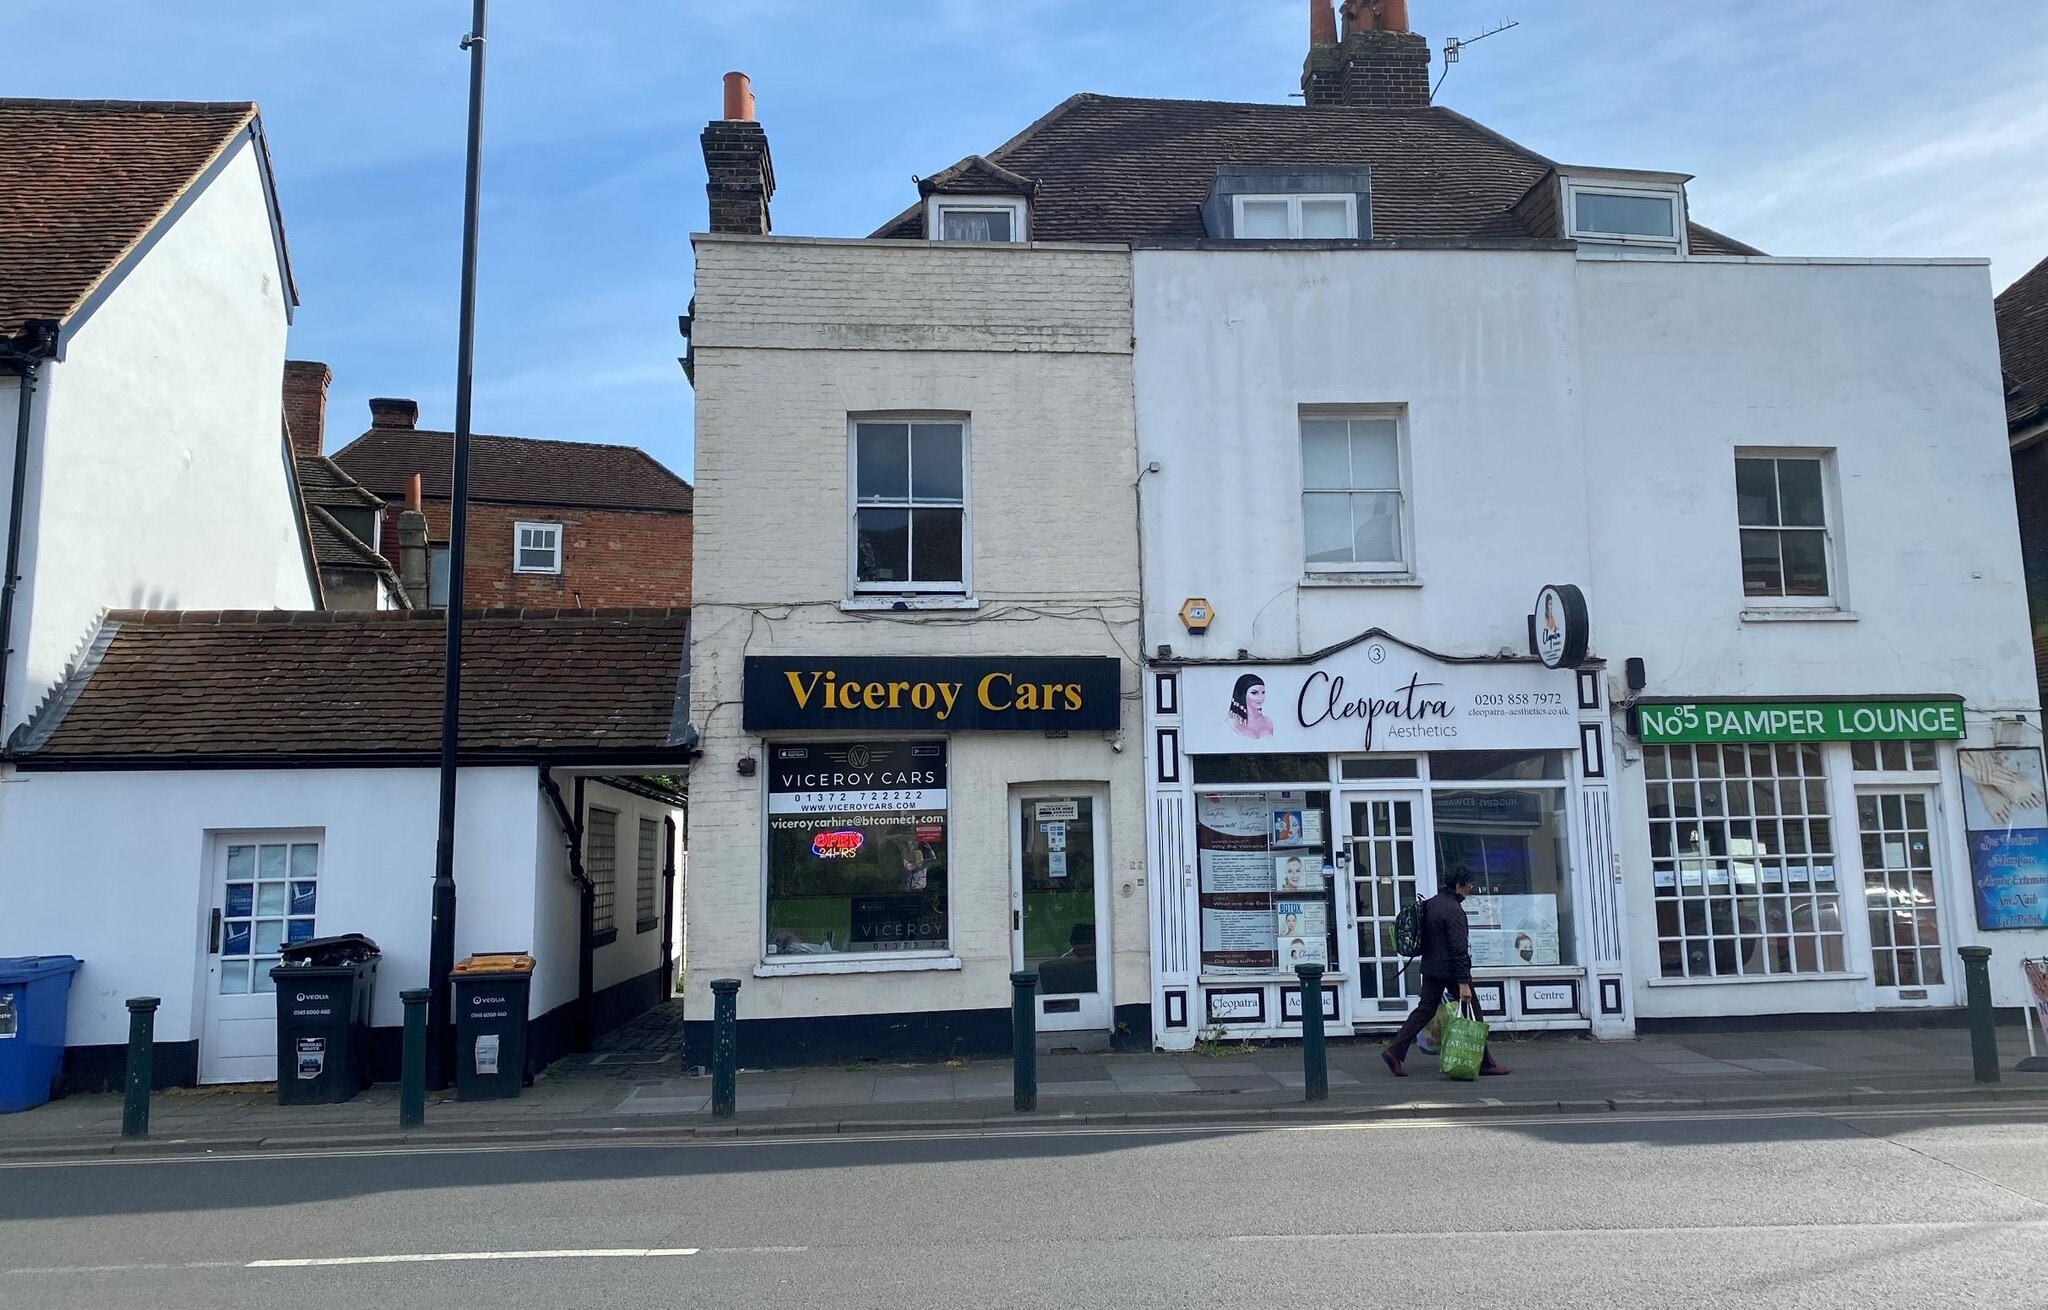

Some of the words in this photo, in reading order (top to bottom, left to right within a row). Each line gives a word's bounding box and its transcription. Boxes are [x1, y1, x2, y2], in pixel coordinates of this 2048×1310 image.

[1190, 609, 1205, 617] ADT
[1372, 647, 1382, 661] 3
[784, 670, 963, 720] Viceroy
[977, 672, 1083, 711] Cars
[1474, 694, 1504, 706] 0203
[1507, 693, 1529, 705] 858
[1533, 692, 1562, 704] 7972
[1297, 671, 1456, 751] Cleopatra
[1705, 709, 1826, 735] PAMPER
[1838, 707, 1958, 733] LOUNGE
[1388, 724, 1458, 737] Aesthetics
[782, 772, 874, 787] VICEROY
[881, 771, 935, 785] CARS
[801, 802, 917, 812] WWW.VICEROYCARS.COM
[814, 832, 861, 848] OPEN
[1280, 903, 1301, 913] BOTOX
[862, 923, 942, 937] VICEROY
[1533, 991, 1565, 1000] Centre
[1212, 998, 1258, 1010] Cleopatra
